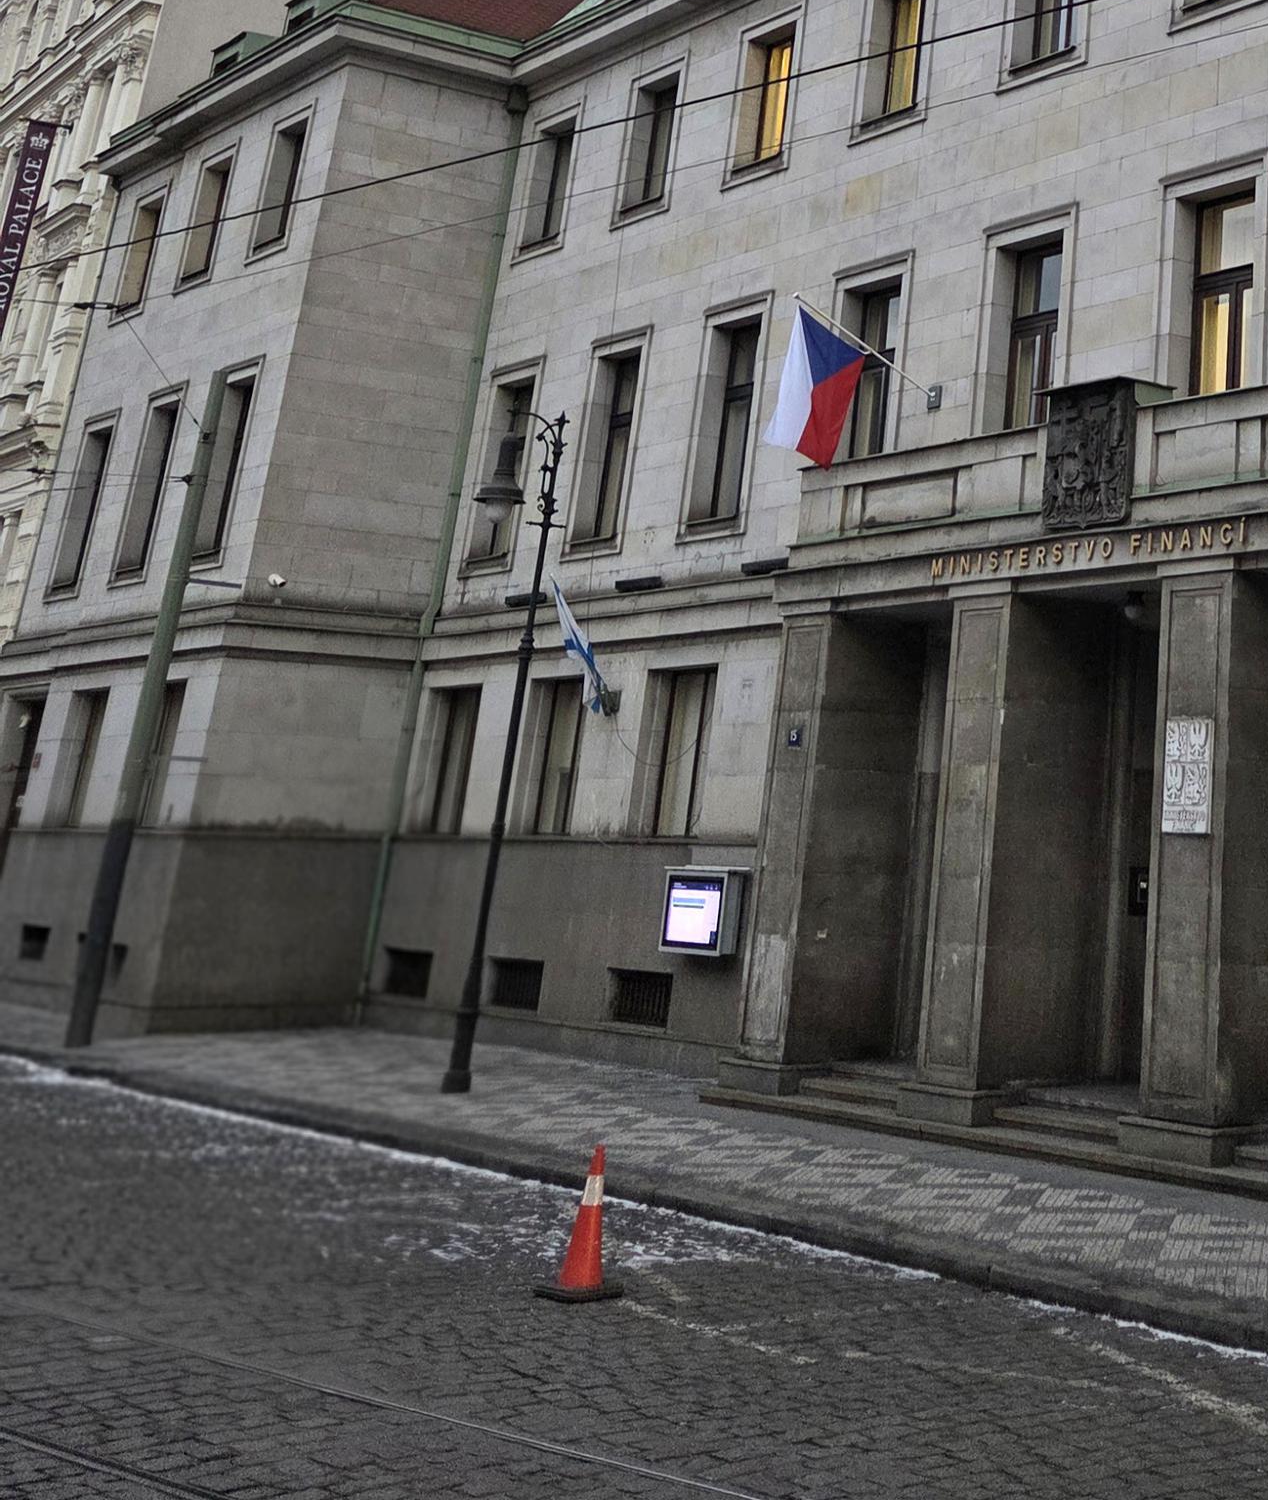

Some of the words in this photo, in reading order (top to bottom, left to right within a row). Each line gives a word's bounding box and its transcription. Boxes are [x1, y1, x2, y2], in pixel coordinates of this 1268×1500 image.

[9, 157, 43, 235] PALACE
[931, 536, 1112, 577] MINISTERSTVO
[1130, 517, 1246, 555] FINANCÍ
